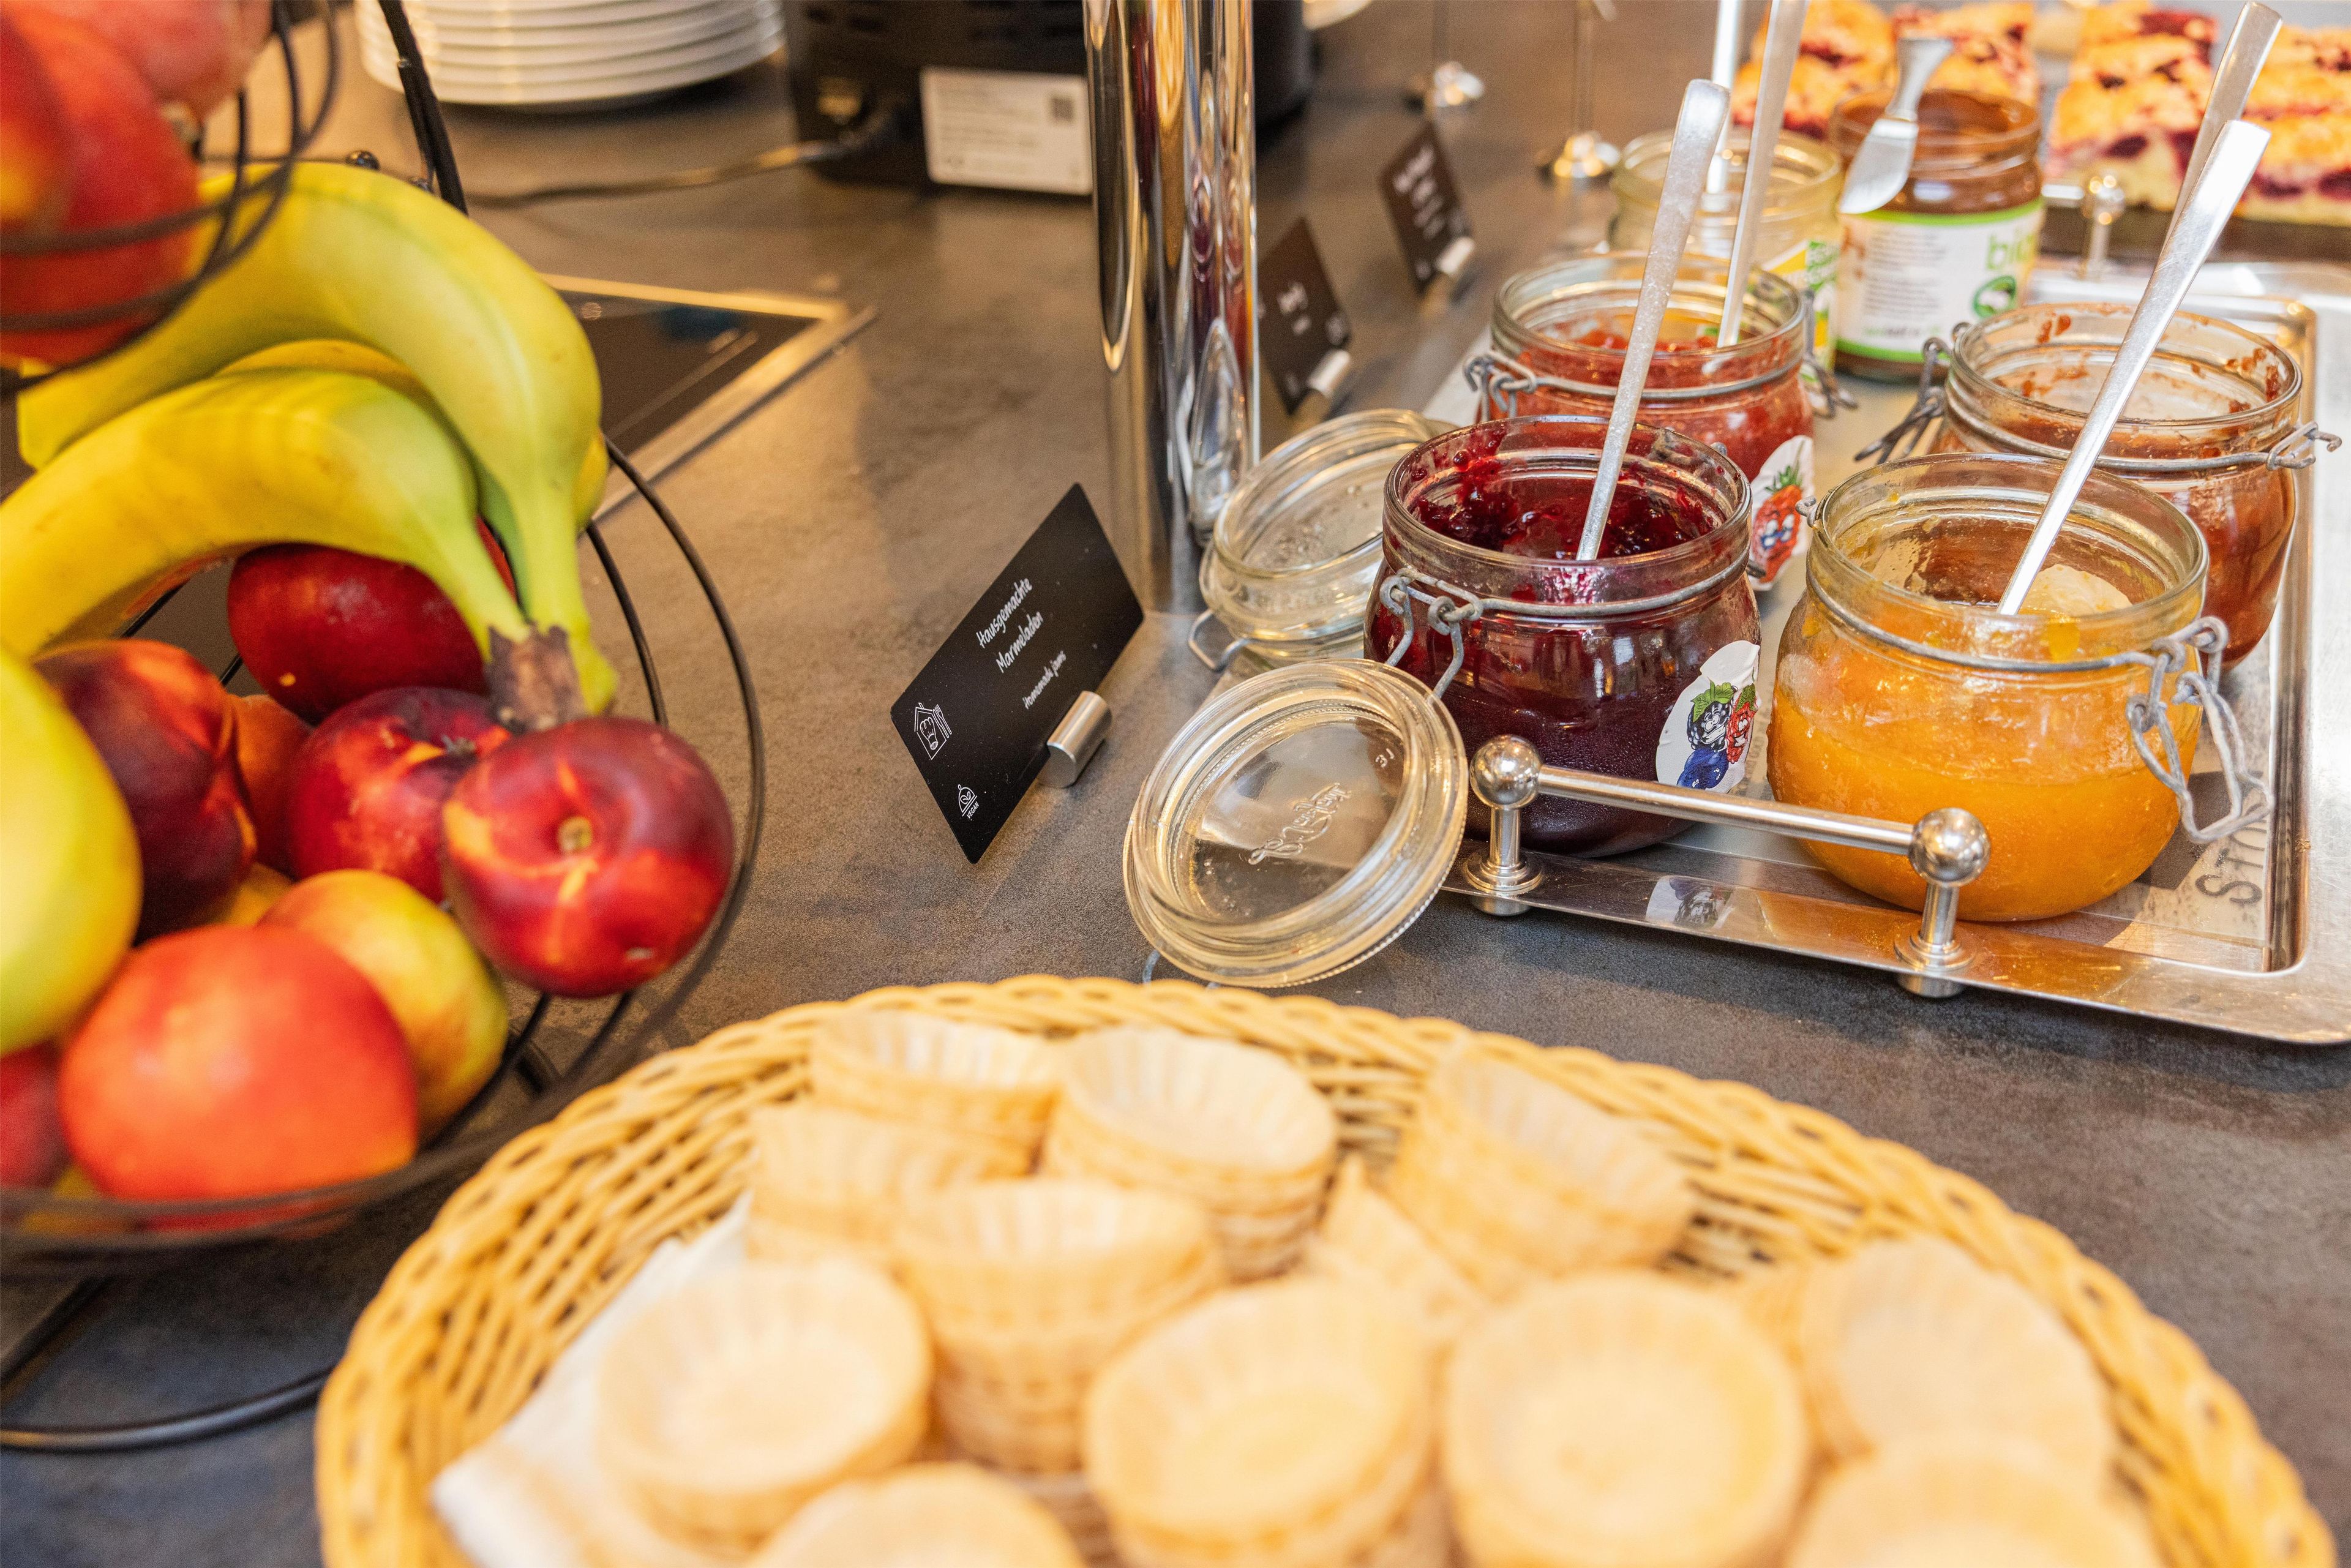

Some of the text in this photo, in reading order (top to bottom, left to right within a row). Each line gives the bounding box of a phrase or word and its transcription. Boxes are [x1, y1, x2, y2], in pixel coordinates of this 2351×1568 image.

[976, 578, 1032, 648] Hausgemachte
[996, 612, 1043, 673] Marmeladen
[1022, 666, 1054, 710] Homemade
[966, 801, 979, 819] VEGAN
